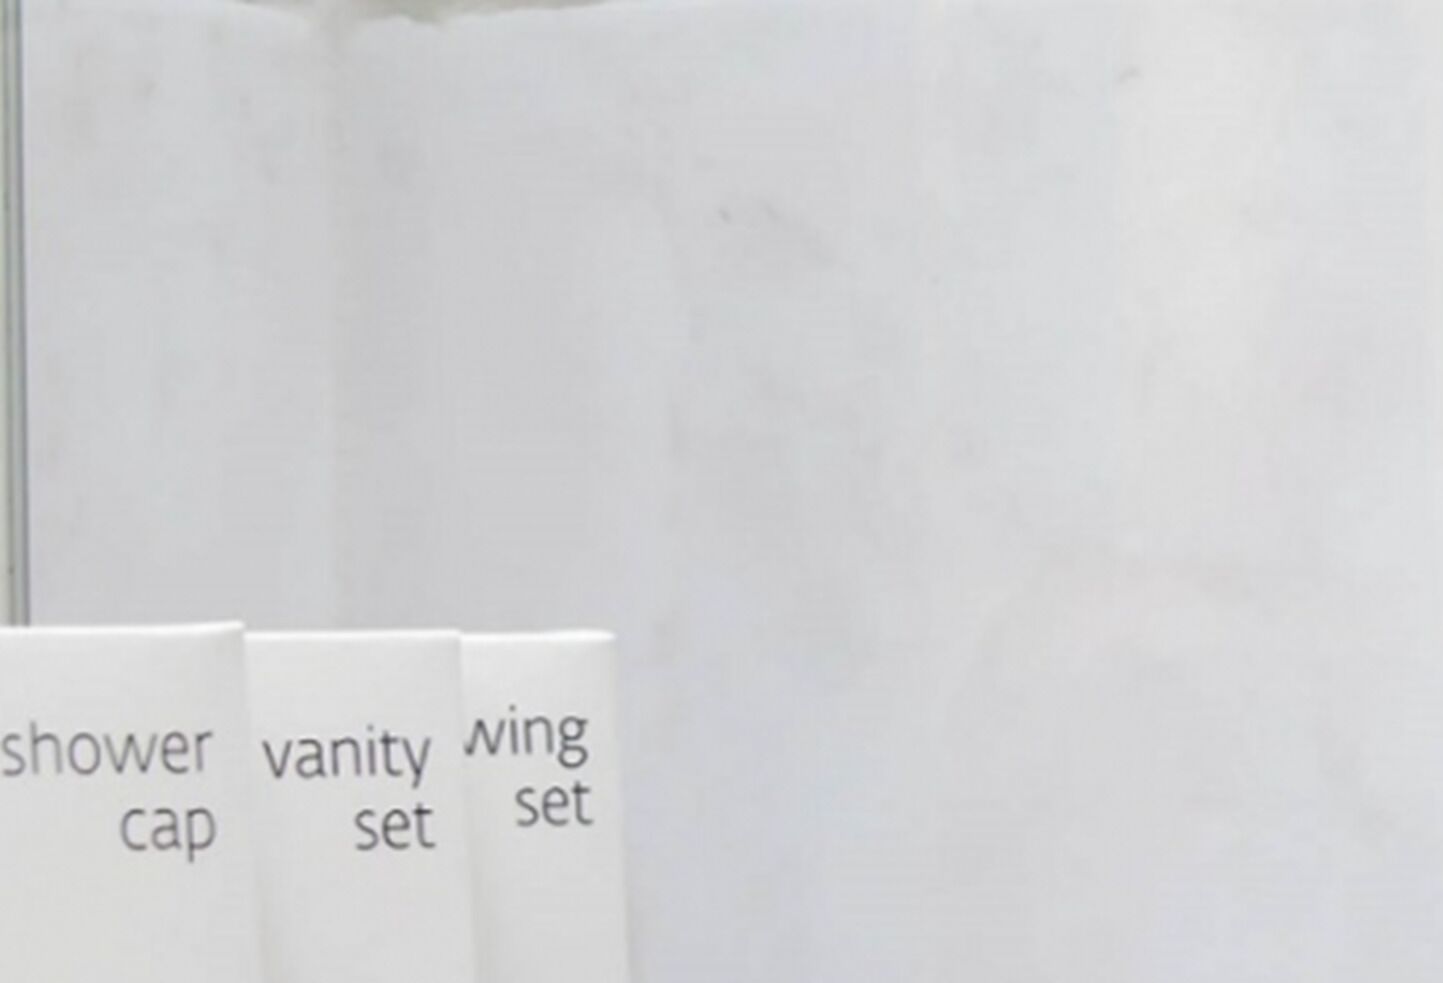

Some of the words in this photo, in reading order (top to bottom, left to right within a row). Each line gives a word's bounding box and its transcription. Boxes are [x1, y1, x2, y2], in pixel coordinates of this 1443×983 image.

[1, 721, 214, 778] shower
[262, 724, 431, 789] vanity
[355, 803, 436, 852] set
[515, 780, 594, 827] set
[120, 807, 217, 863] cap
